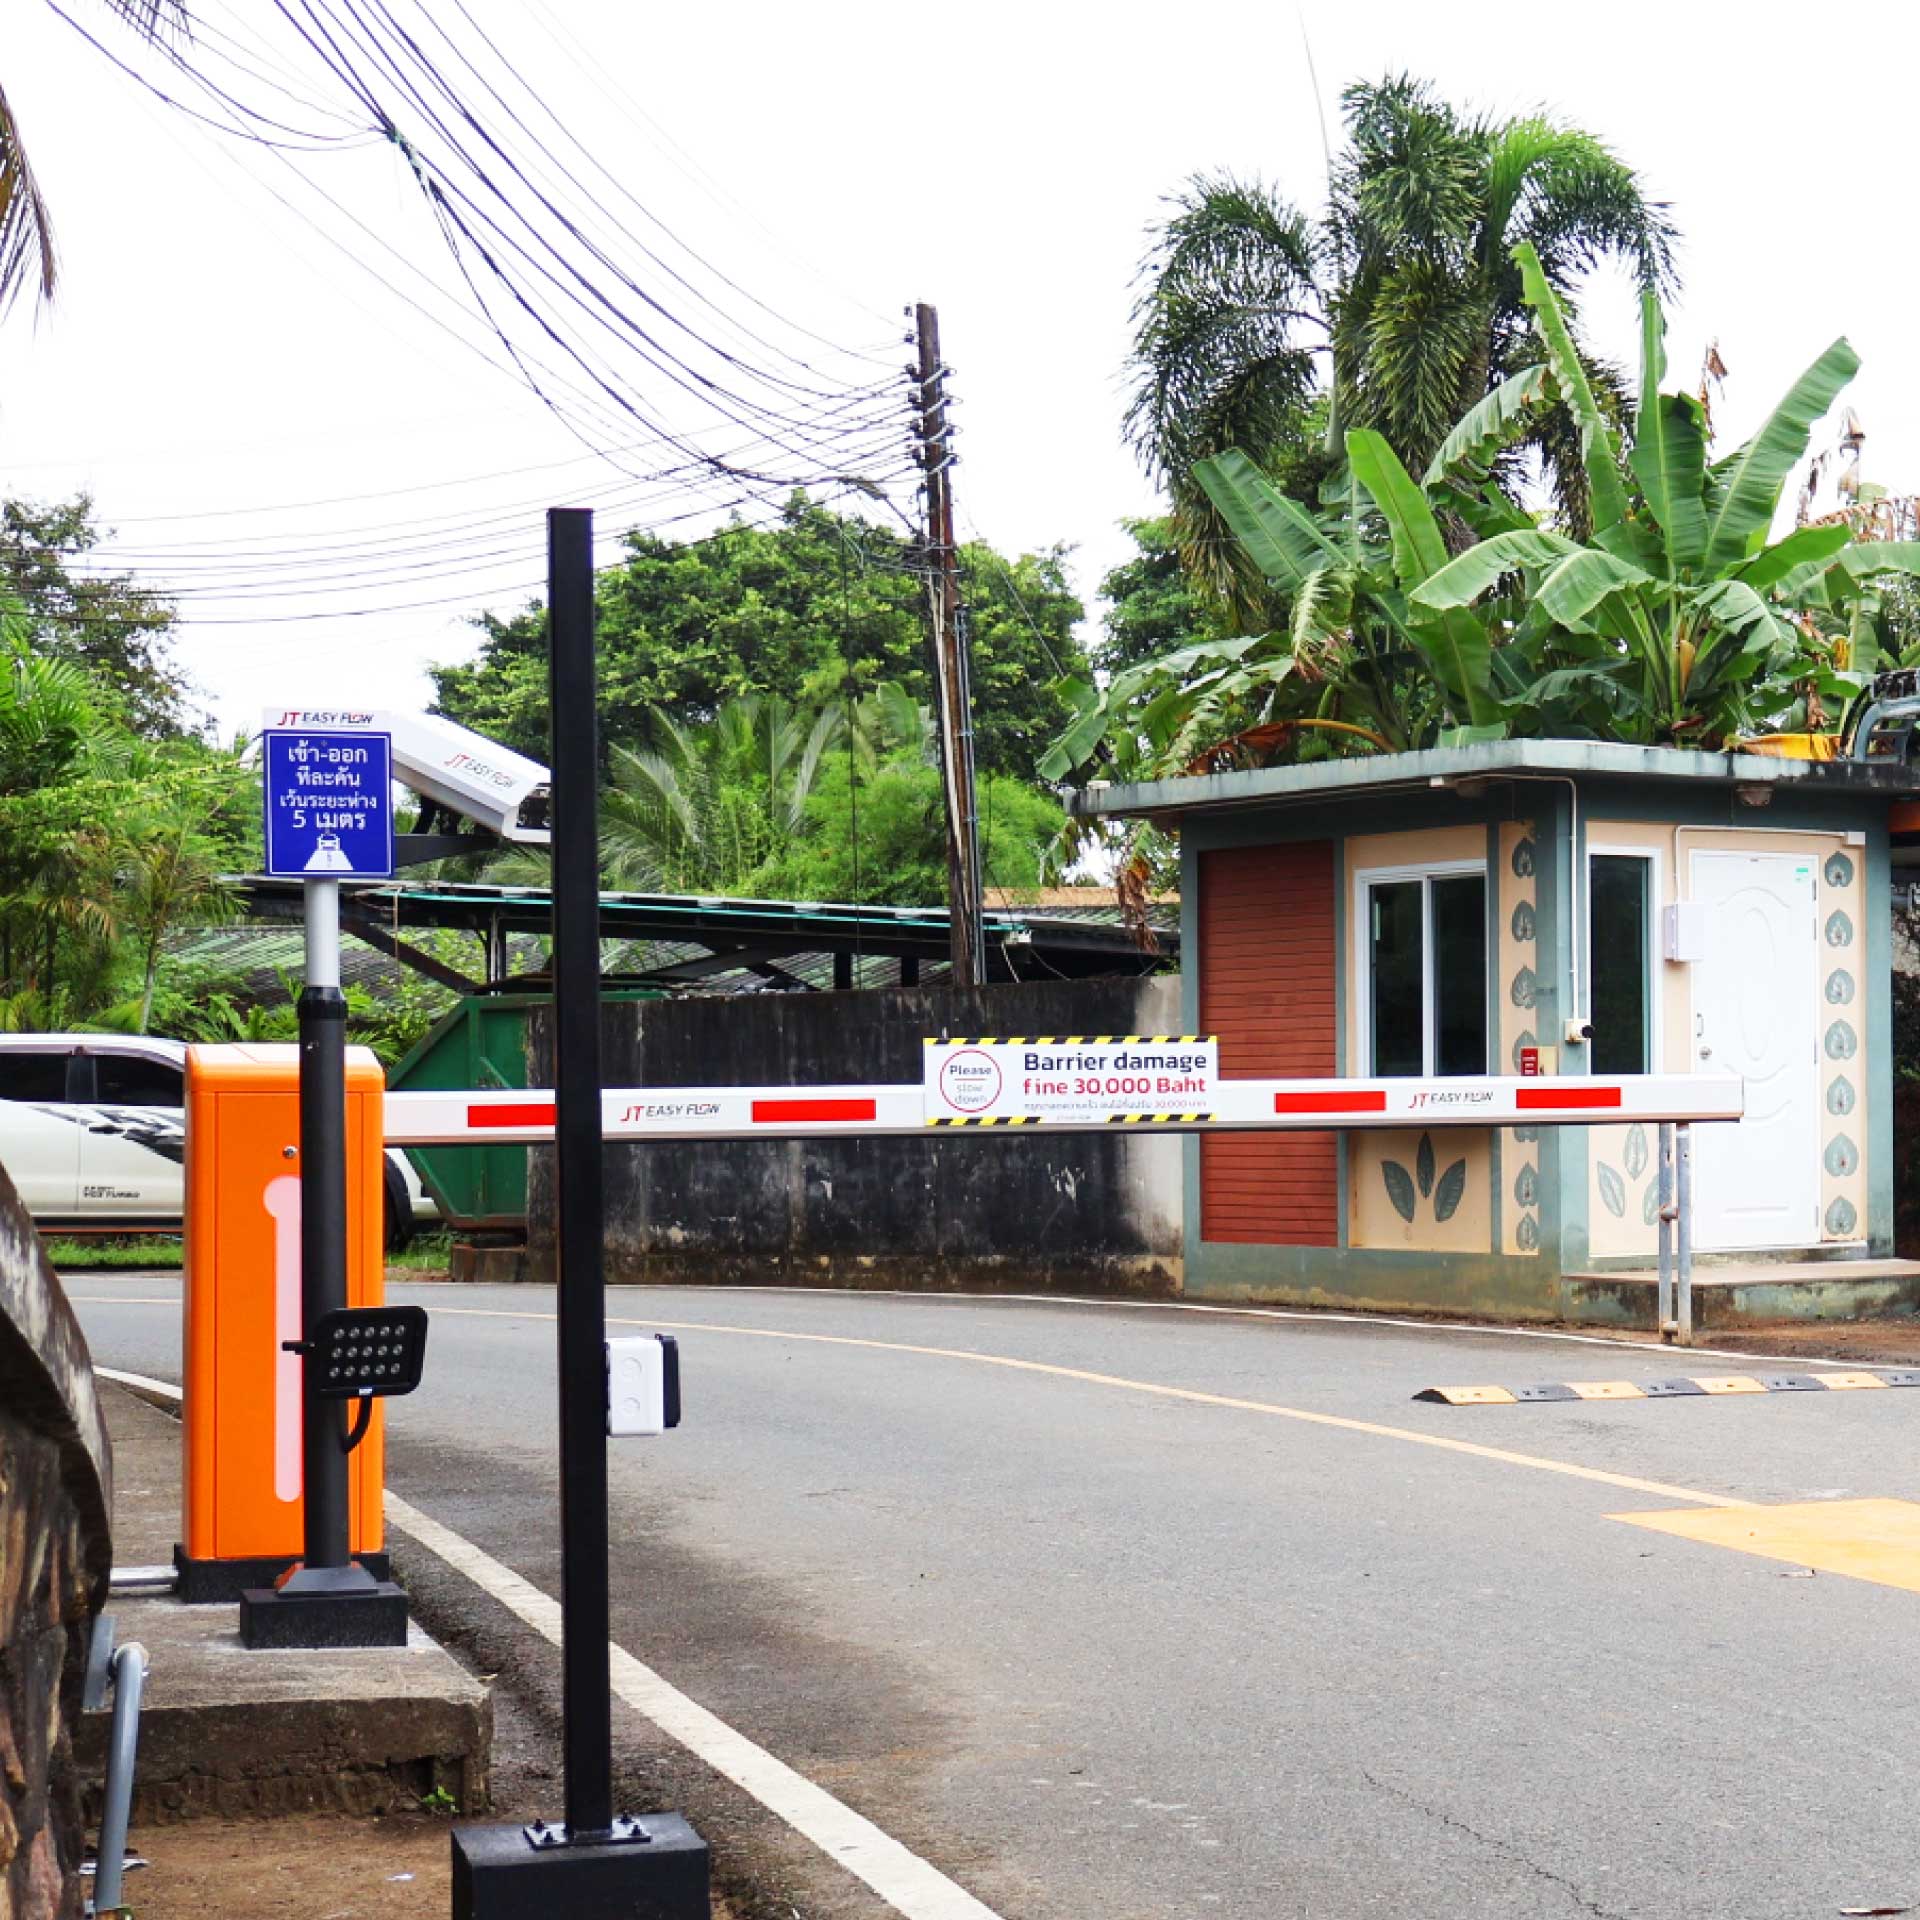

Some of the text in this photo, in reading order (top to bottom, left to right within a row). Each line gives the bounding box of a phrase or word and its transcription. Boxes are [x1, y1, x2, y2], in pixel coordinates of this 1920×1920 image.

[277, 712, 374, 726] JT EASY FLOW
[288, 739, 368, 763] เข้า-ออก
[292, 810, 366, 830] 5 เมตร
[949, 1064, 992, 1075] Please
[1024, 1052, 1207, 1072] Barrier damage
[1023, 1077, 1206, 1096] fine 30,000 Baht
[1407, 1092, 1429, 1108] JT
[1430, 1092, 1461, 1103] EASY
[620, 1103, 721, 1121] JT EASY FLOW
